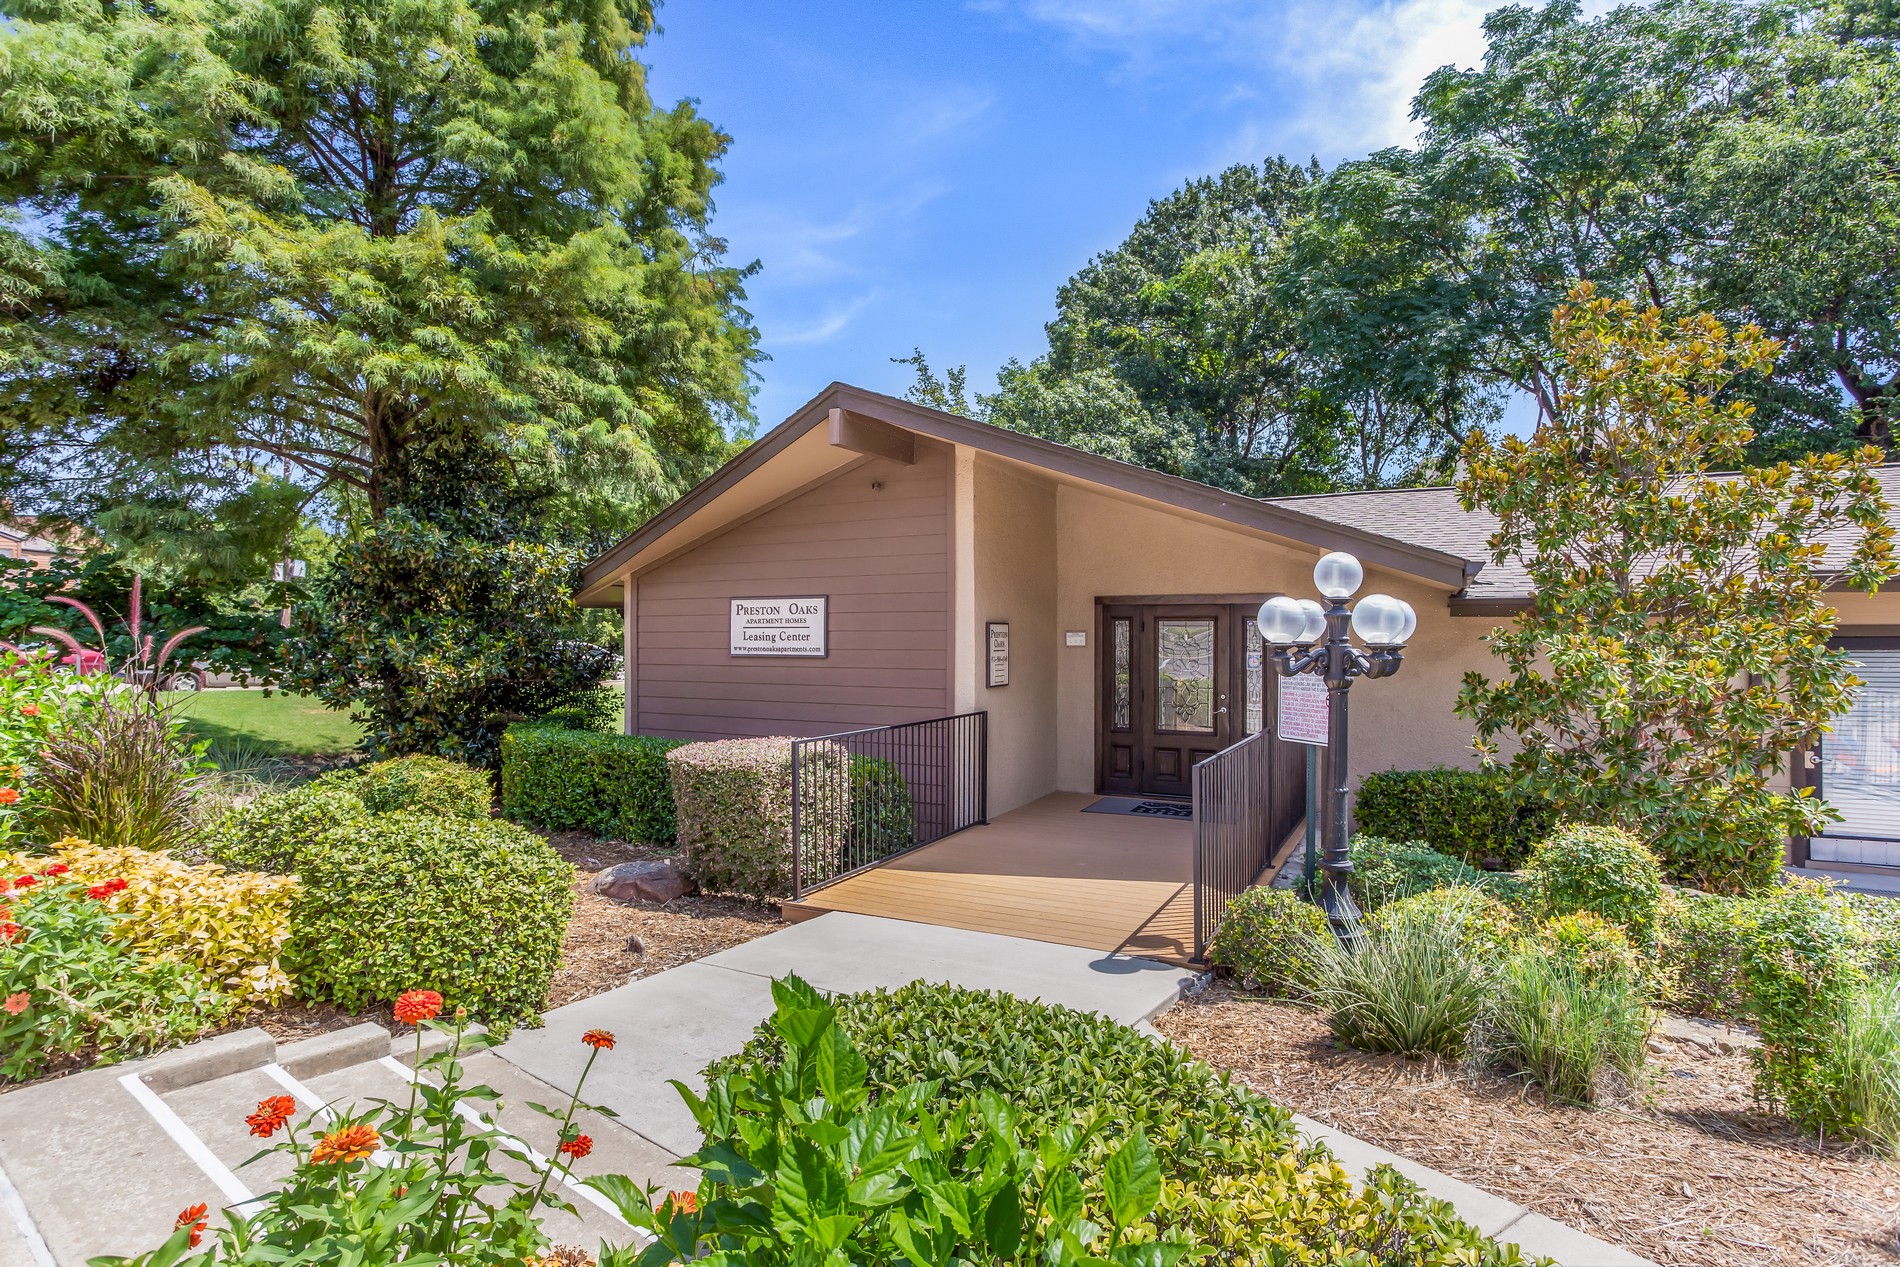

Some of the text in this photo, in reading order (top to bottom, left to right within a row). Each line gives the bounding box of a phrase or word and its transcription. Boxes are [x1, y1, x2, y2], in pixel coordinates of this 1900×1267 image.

[736, 603, 818, 615] PRESTON OAKS
[743, 631, 810, 643] Leasing Center
[734, 645, 821, 653] www.prestonoaksapartments.com
